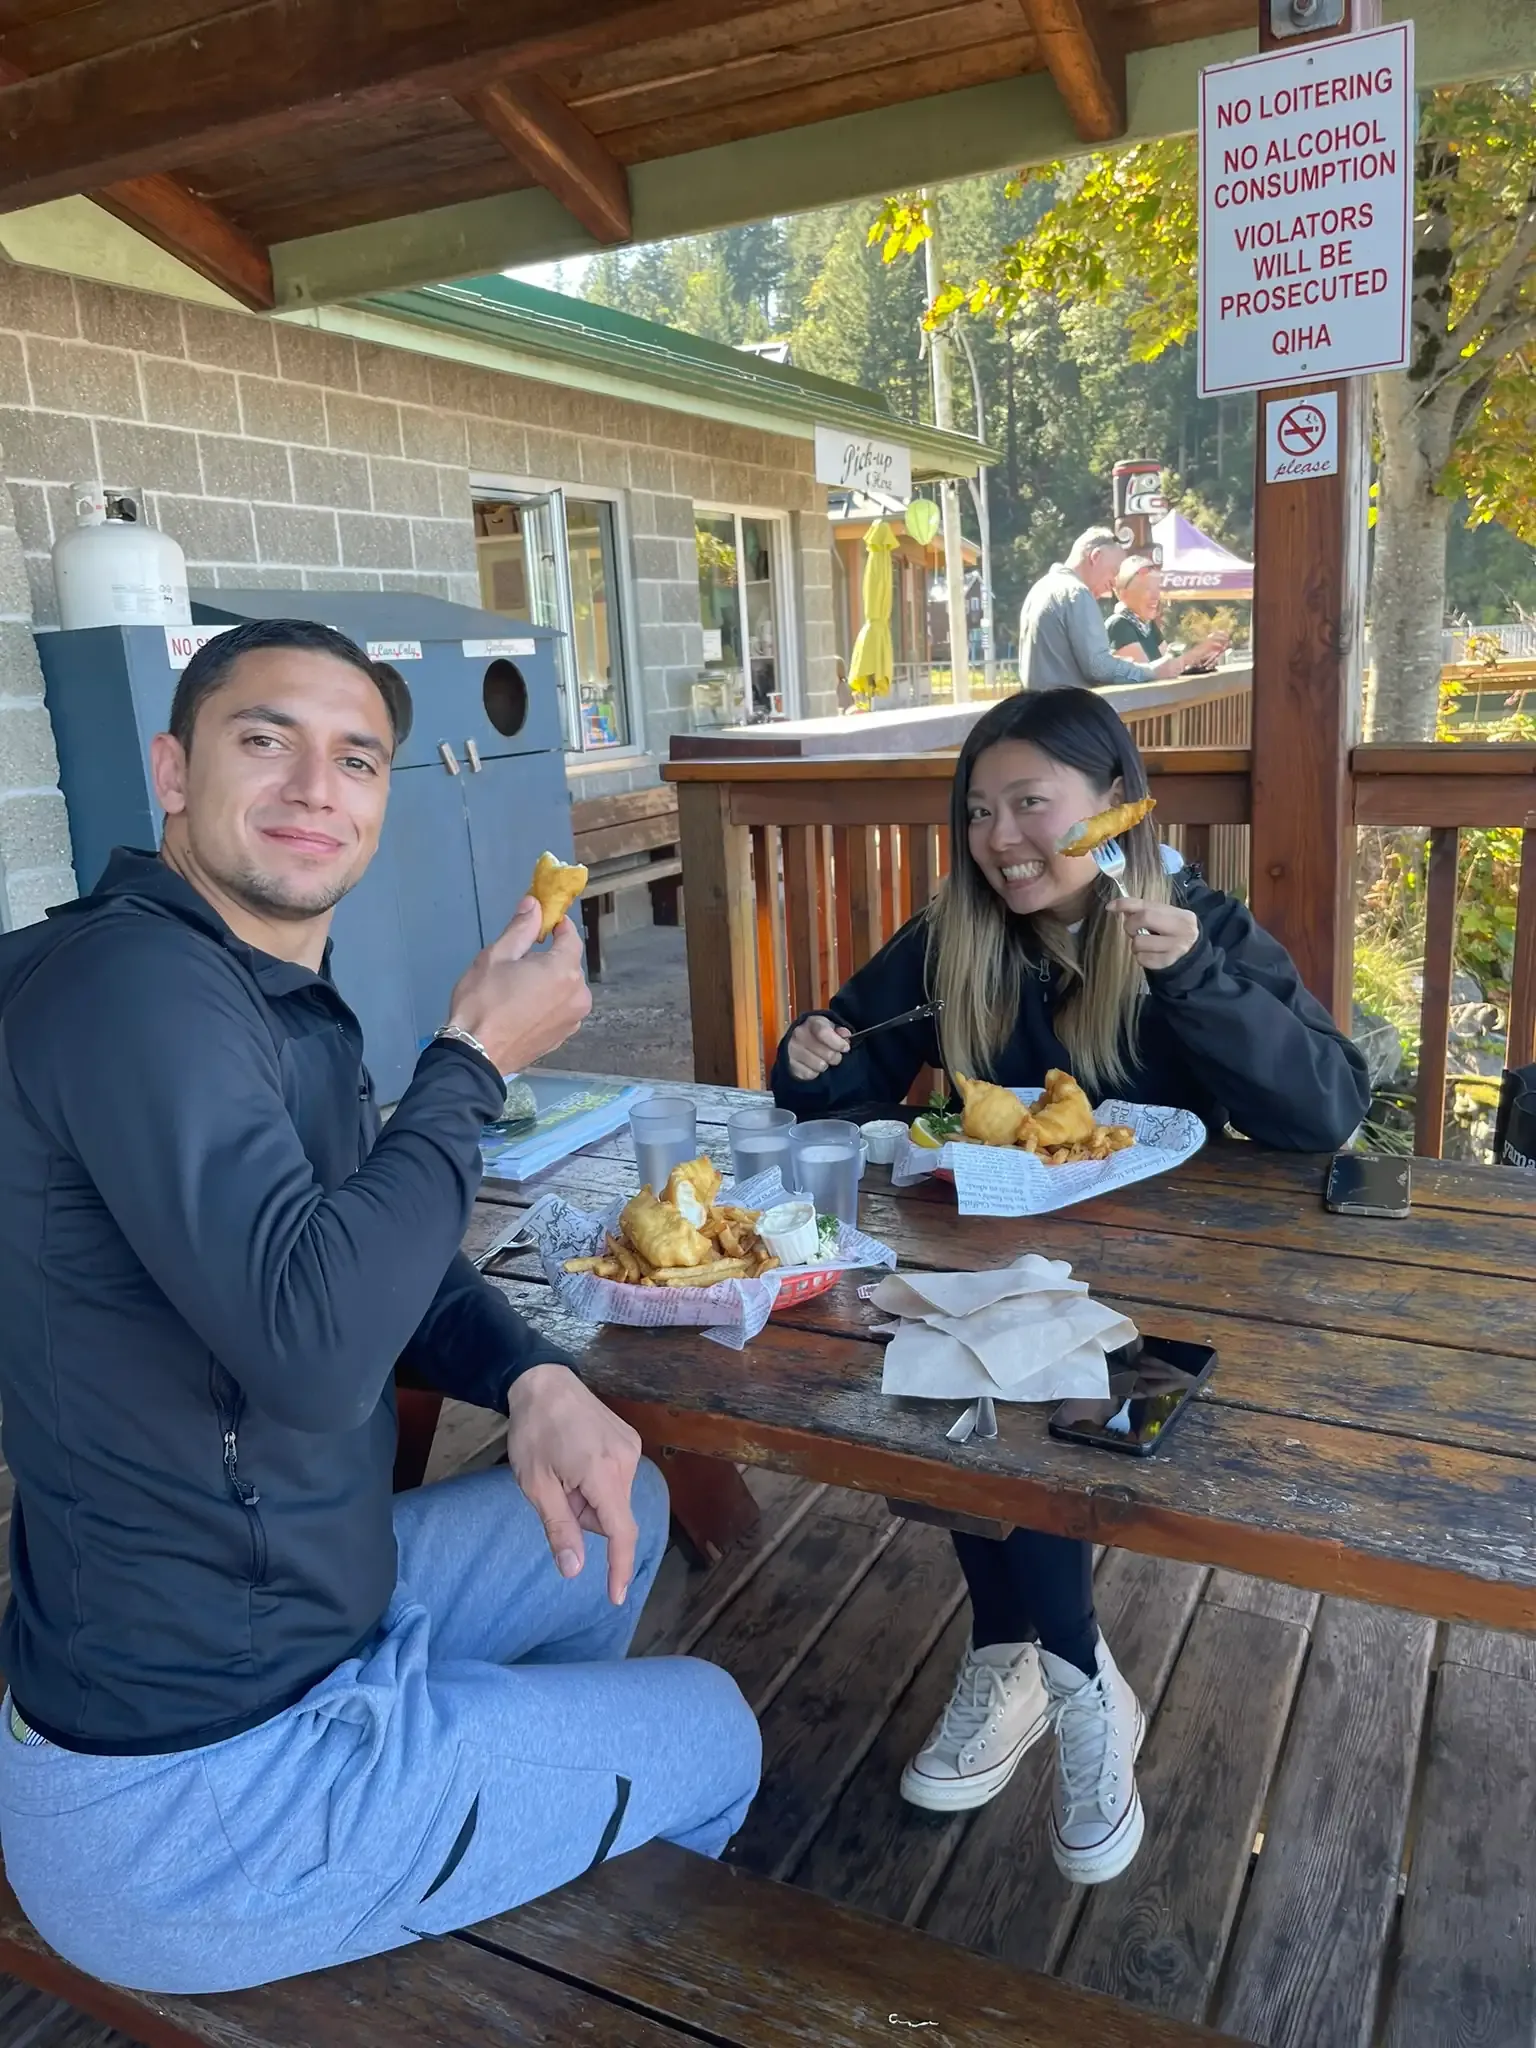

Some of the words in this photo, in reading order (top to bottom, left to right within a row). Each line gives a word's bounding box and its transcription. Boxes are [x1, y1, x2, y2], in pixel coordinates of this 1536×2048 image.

[1217, 99, 1251, 129] NO
[1260, 67, 1393, 120] LOITERING
[1224, 145, 1258, 174] NO
[1265, 119, 1386, 167] ALCOHOL
[1214, 150, 1396, 208] CONSUMPTION
[1234, 202, 1374, 251] VIOLATORS
[1253, 249, 1312, 281] WILL
[1320, 240, 1353, 270] BE
[1221, 268, 1388, 321] PROSECUTED
[1272, 324, 1332, 356] QIHA
[840, 442, 893, 485] Pick-up
[1273, 458, 1331, 480] please
[1160, 571, 1222, 588] Ferries
[171, 637, 192, 656] NO
